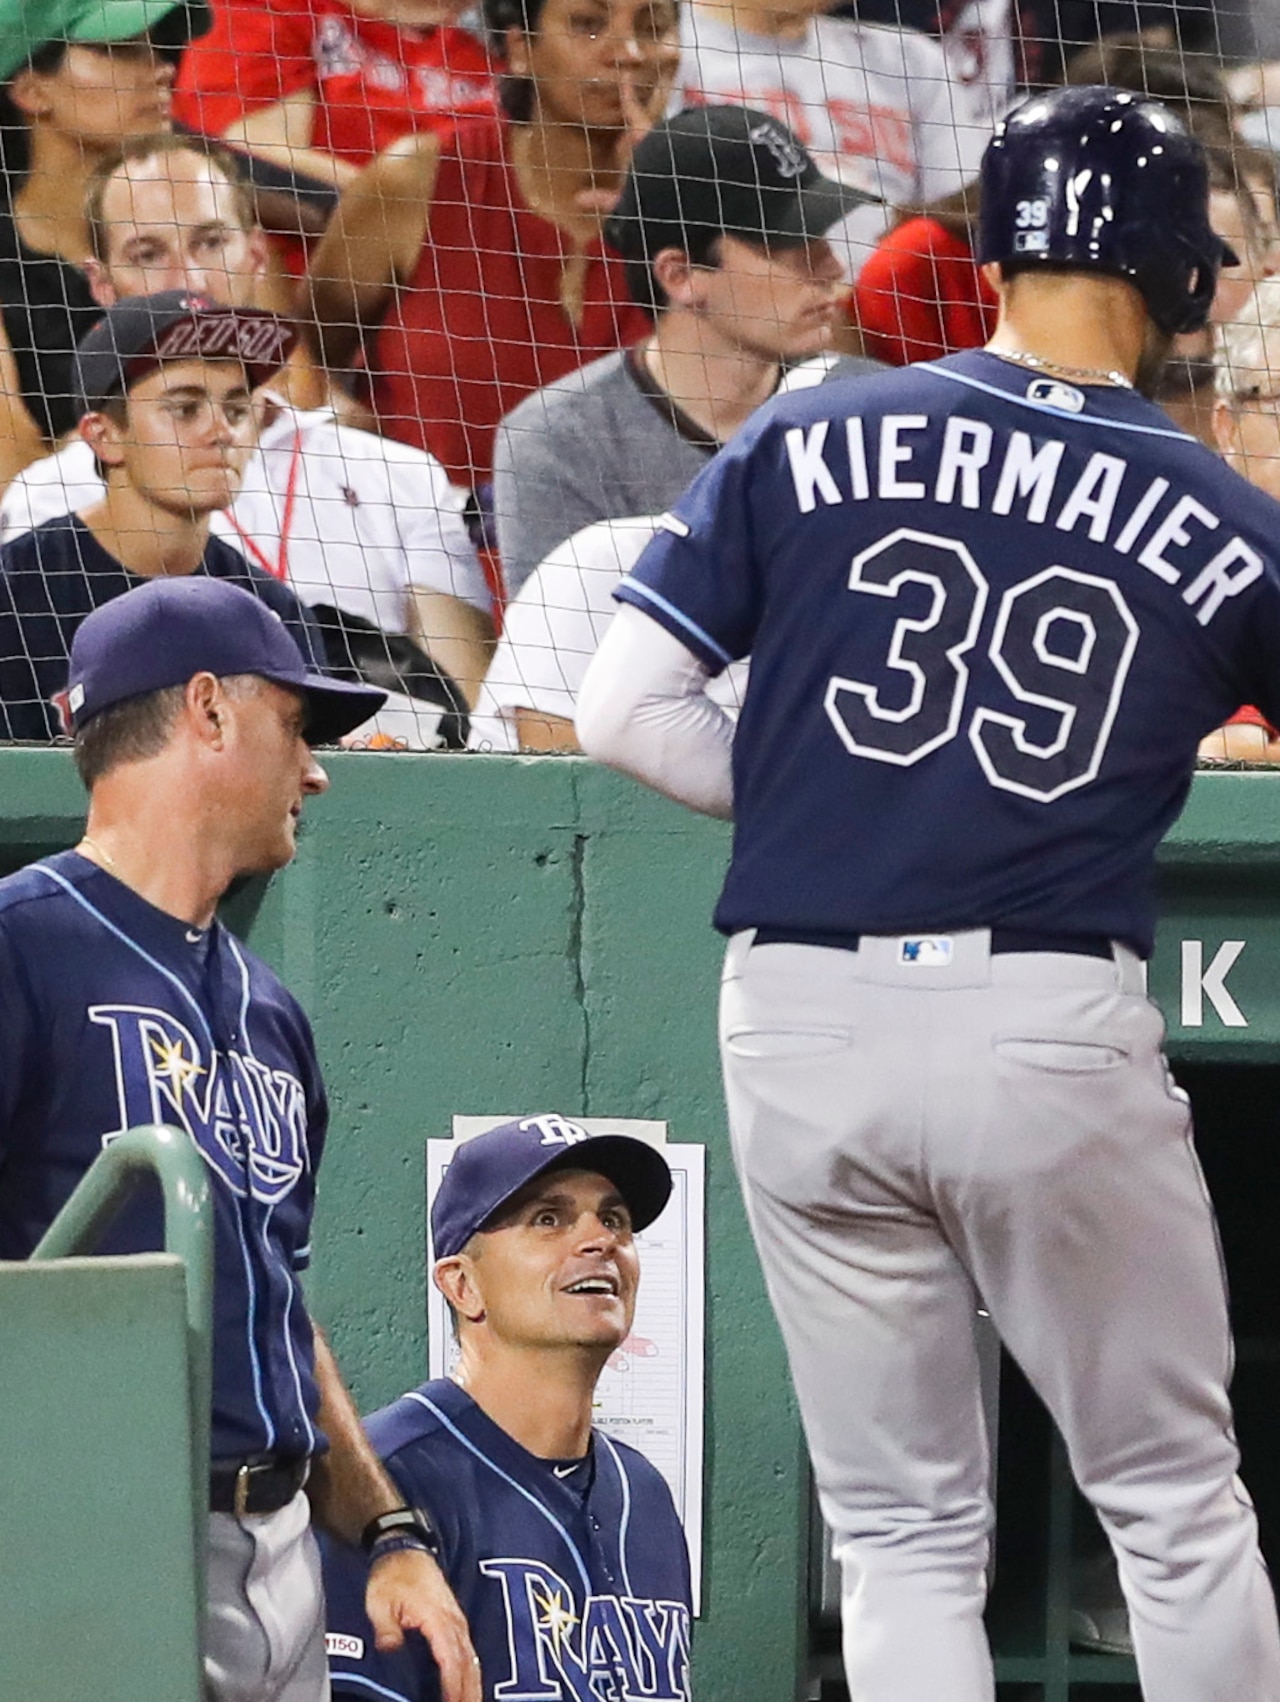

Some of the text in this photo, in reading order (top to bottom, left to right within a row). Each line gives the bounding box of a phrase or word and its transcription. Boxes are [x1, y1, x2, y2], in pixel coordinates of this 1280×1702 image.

[1015, 199, 1047, 229] 39
[157, 318, 238, 356] RED
[785, 414, 1265, 627] KIERMAIER
[823, 527, 1140, 803] 39
